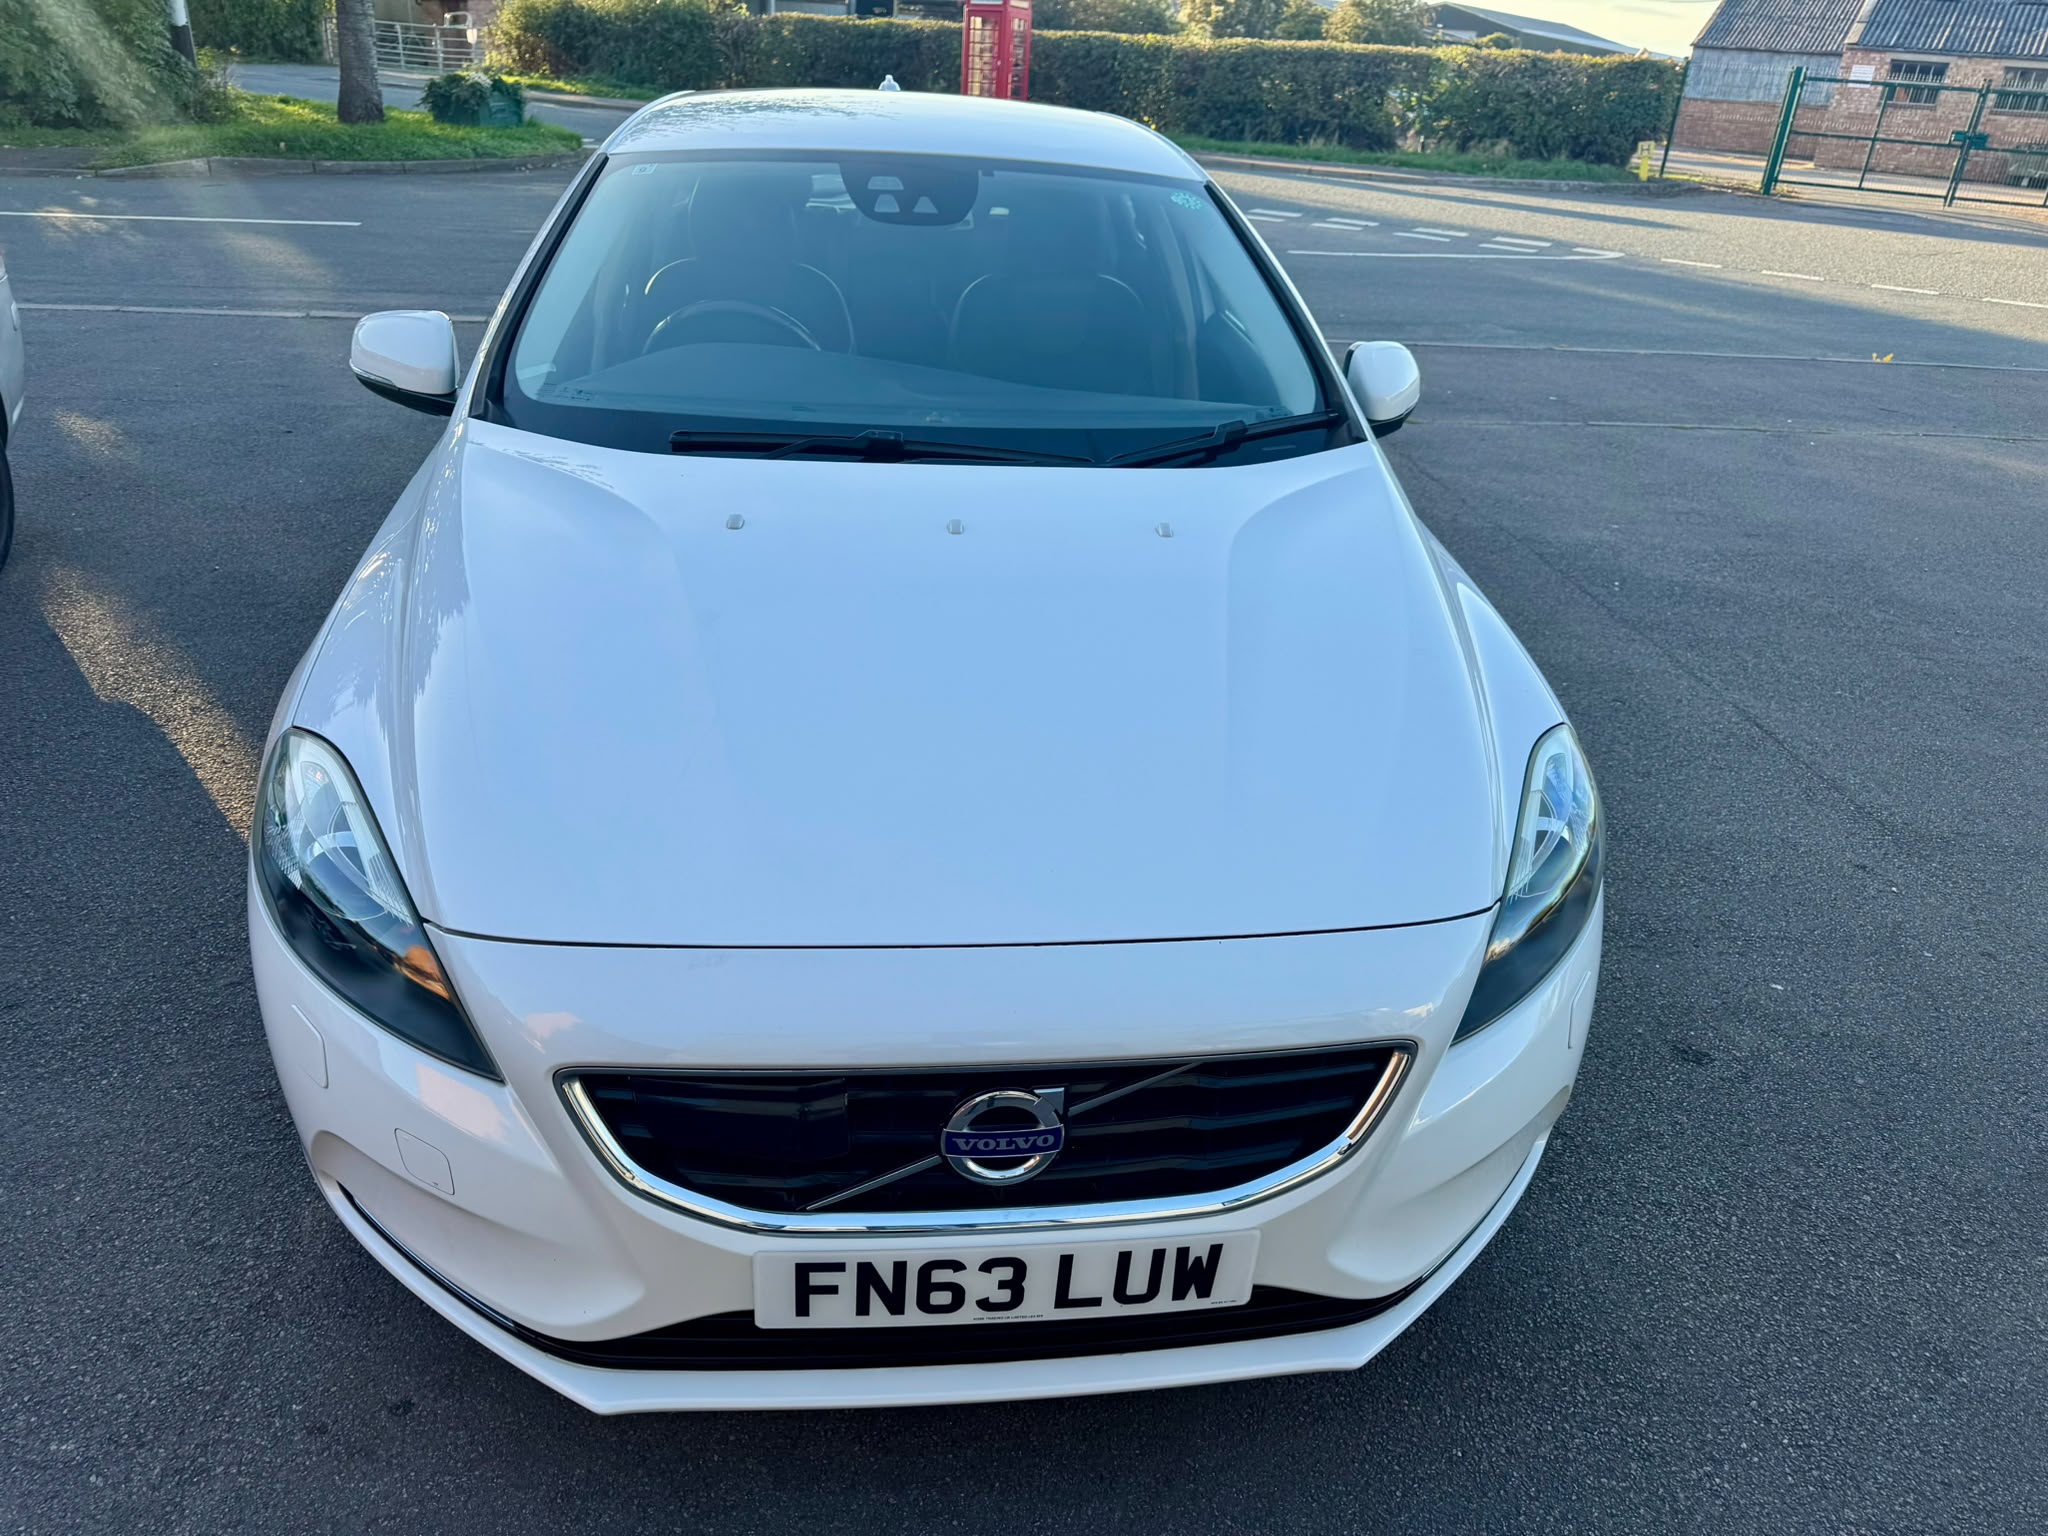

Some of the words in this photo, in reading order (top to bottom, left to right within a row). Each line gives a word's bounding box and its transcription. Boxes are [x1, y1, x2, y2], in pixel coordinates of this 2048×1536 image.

[952, 1134, 1055, 1151] VOLVO
[794, 1257, 1028, 1317] FN63
[1053, 1243, 1224, 1309] LUW
